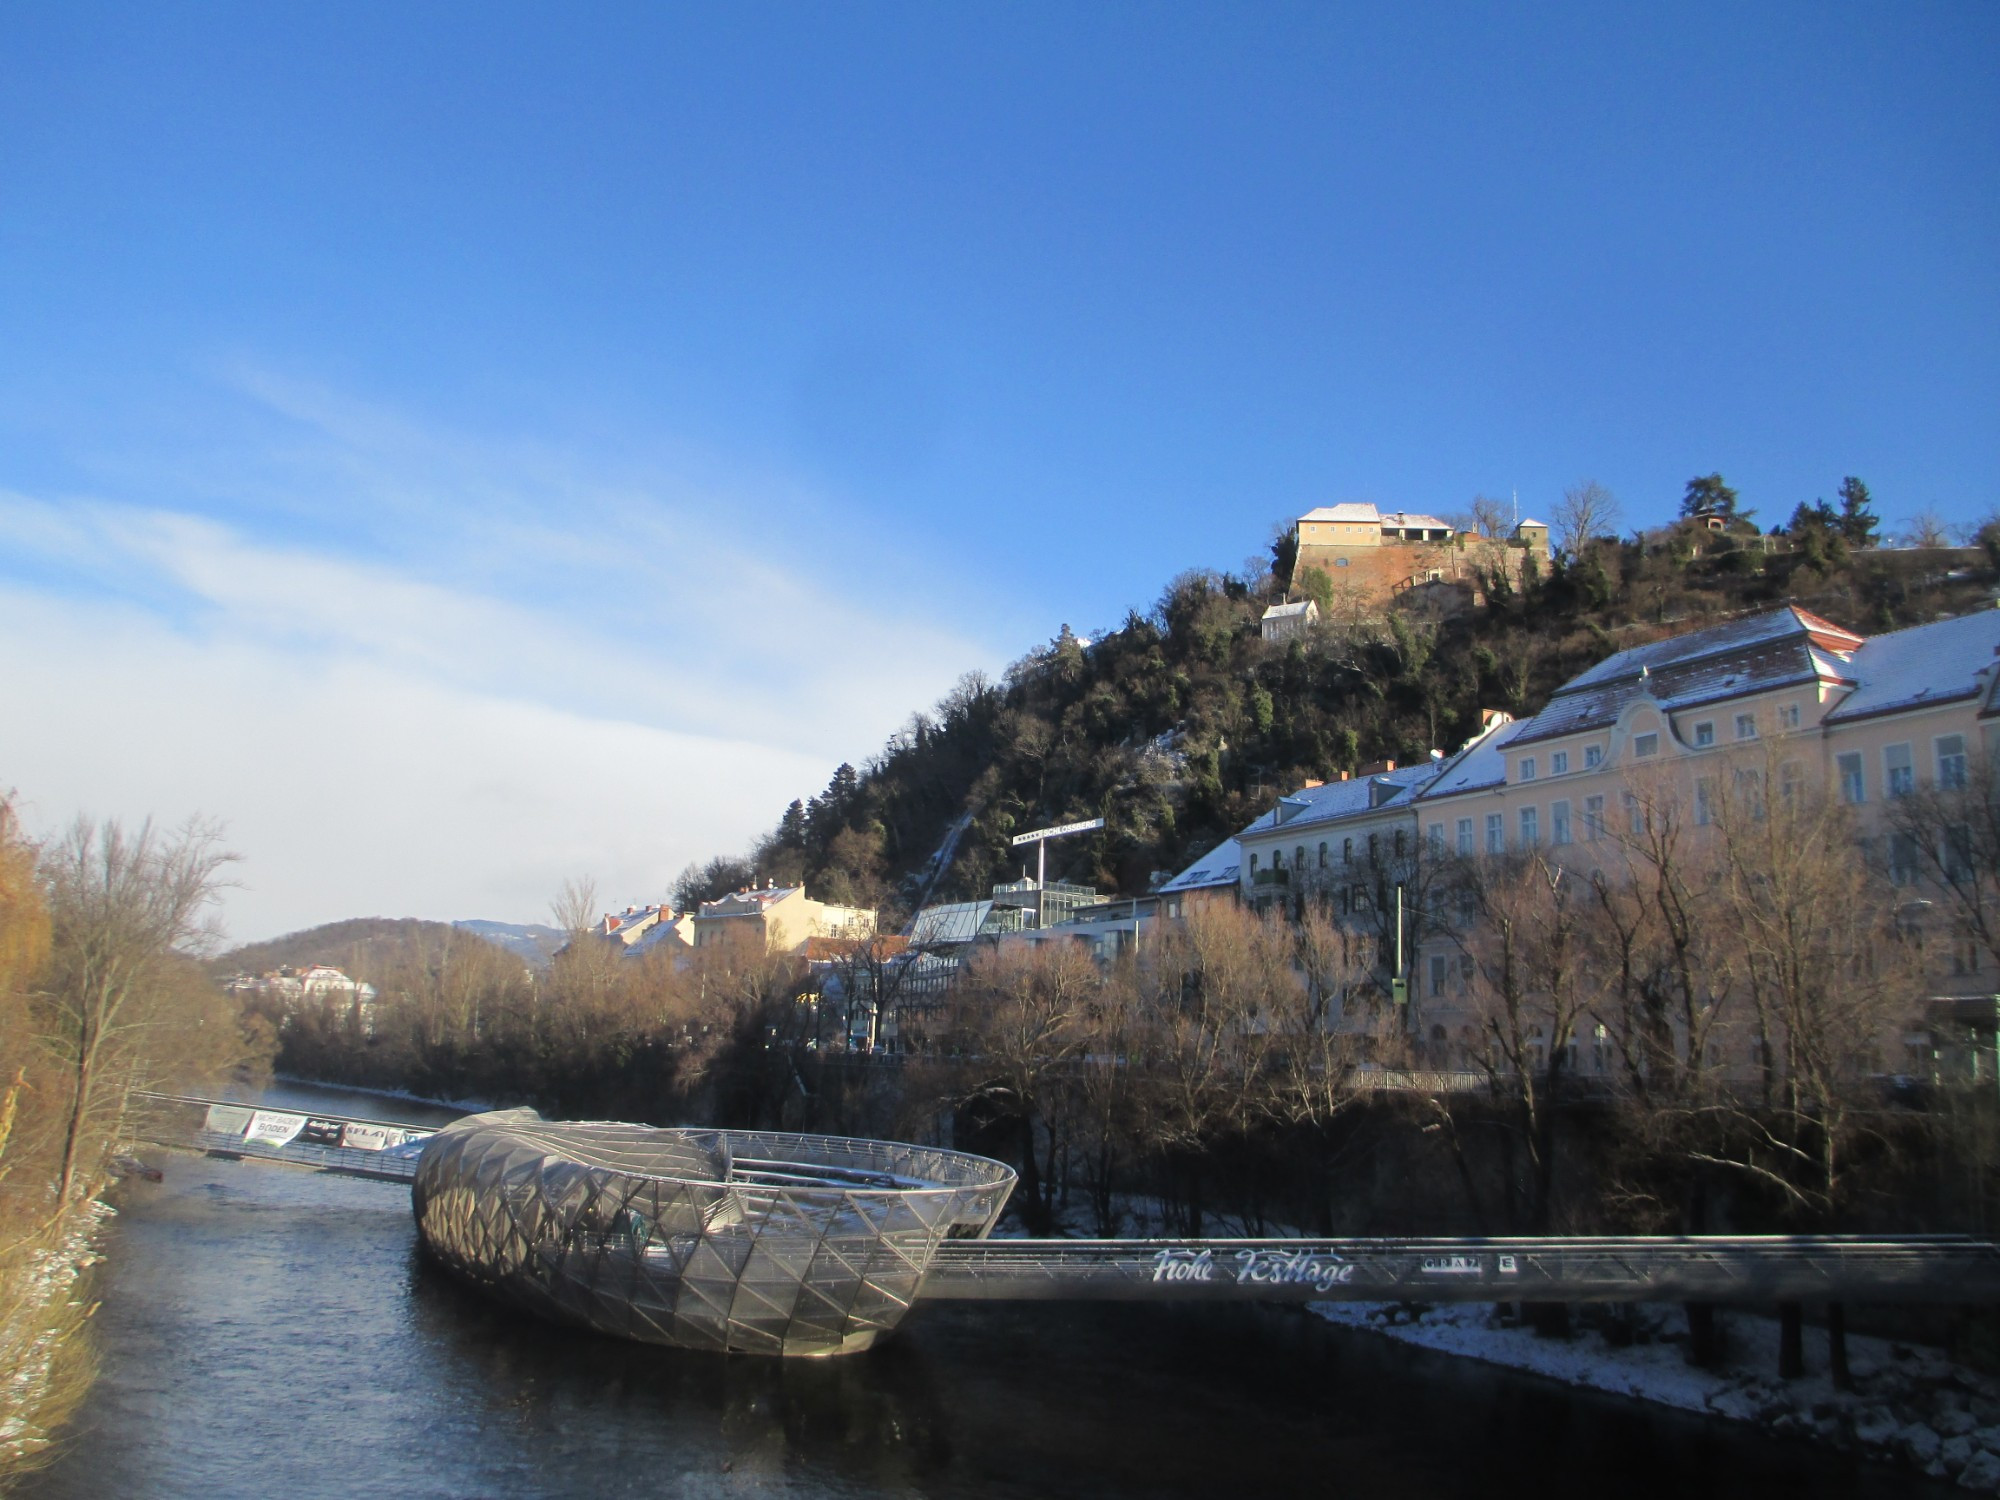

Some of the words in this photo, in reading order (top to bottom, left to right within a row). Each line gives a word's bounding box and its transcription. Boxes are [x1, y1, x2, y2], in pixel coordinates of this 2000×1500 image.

[1043, 820, 1097, 837] SCHLOSSBERG
[1153, 1248, 1214, 1282] Frohe
[1235, 1248, 1355, 1292] Festtage
[1423, 1257, 1479, 1270] GRAZ
